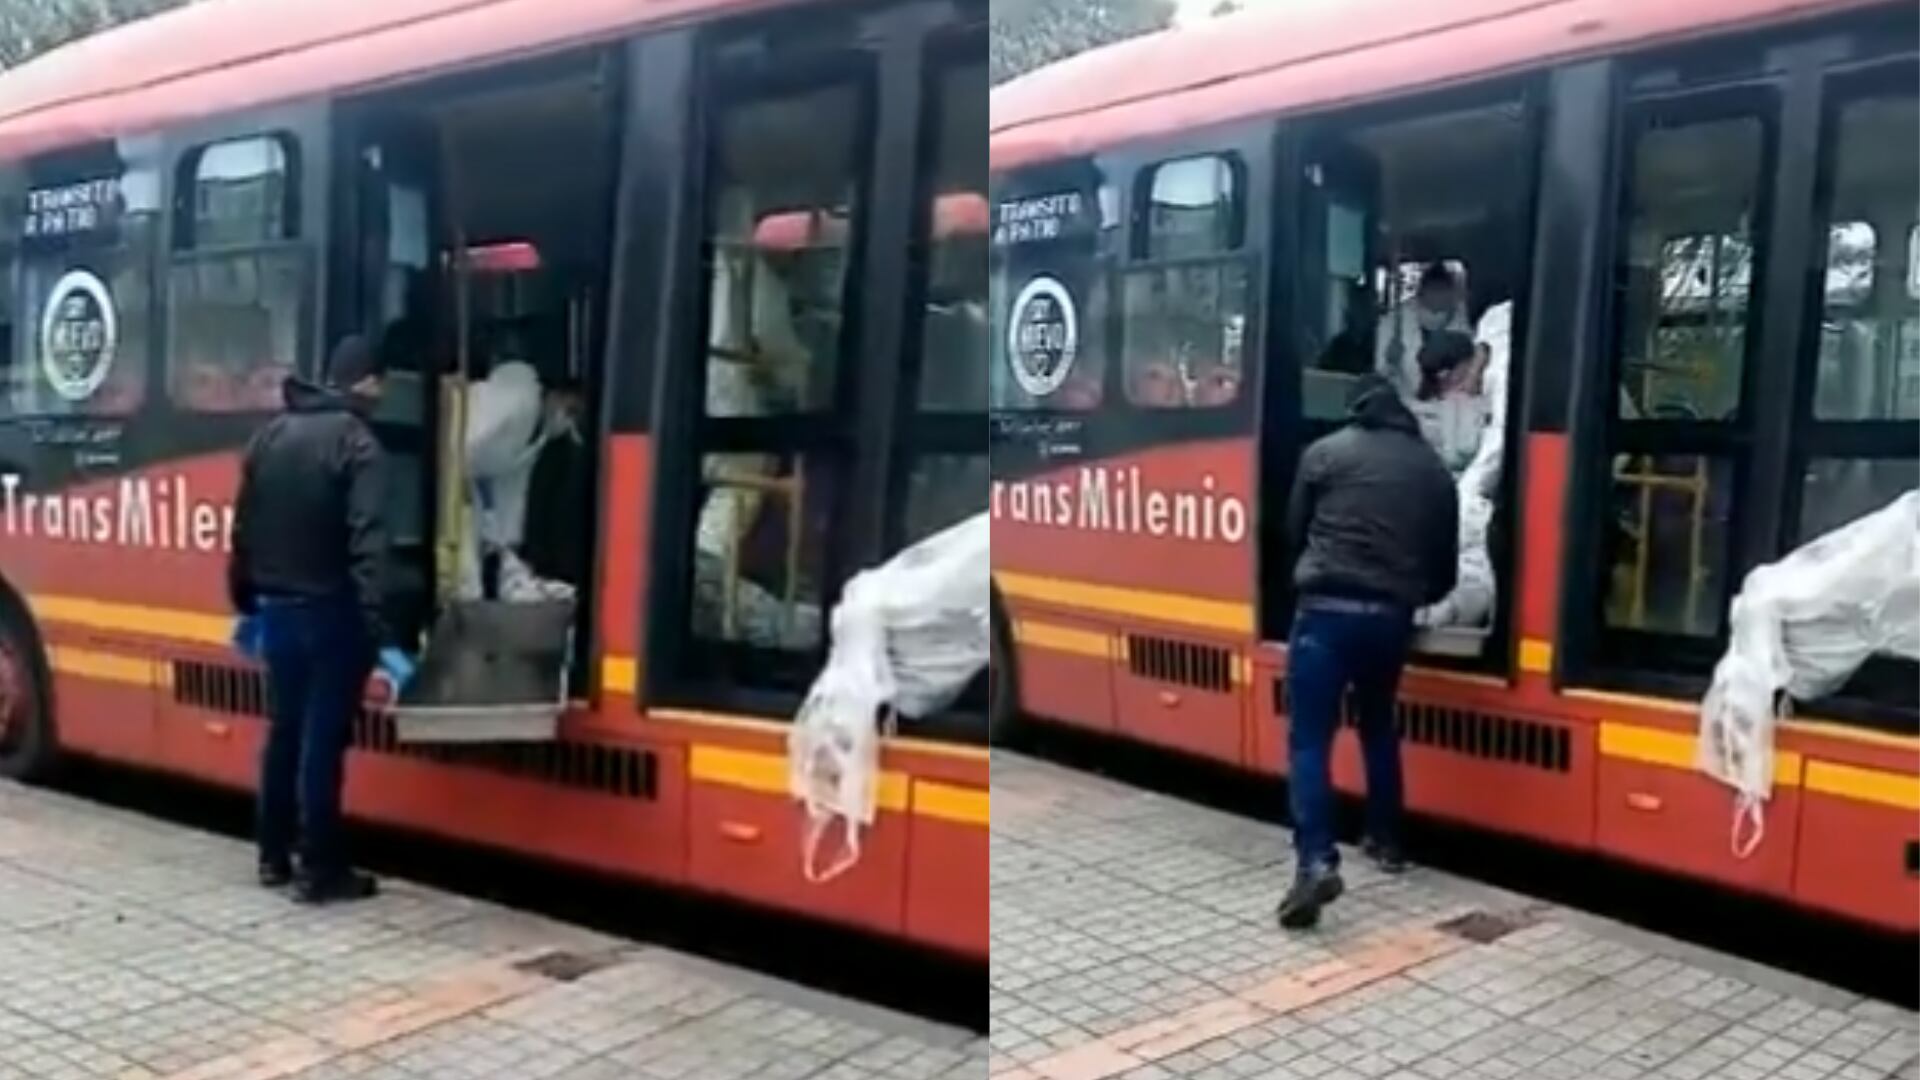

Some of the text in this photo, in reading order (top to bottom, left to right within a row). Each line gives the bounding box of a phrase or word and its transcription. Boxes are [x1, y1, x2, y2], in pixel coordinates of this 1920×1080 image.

[42, 206, 96, 234] PATIO
[1000, 193, 1081, 222] TRANSITO
[1009, 218, 1059, 243] PATIO
[1, 473, 234, 553] TransMile
[991, 466, 1245, 542] ransMilenio
